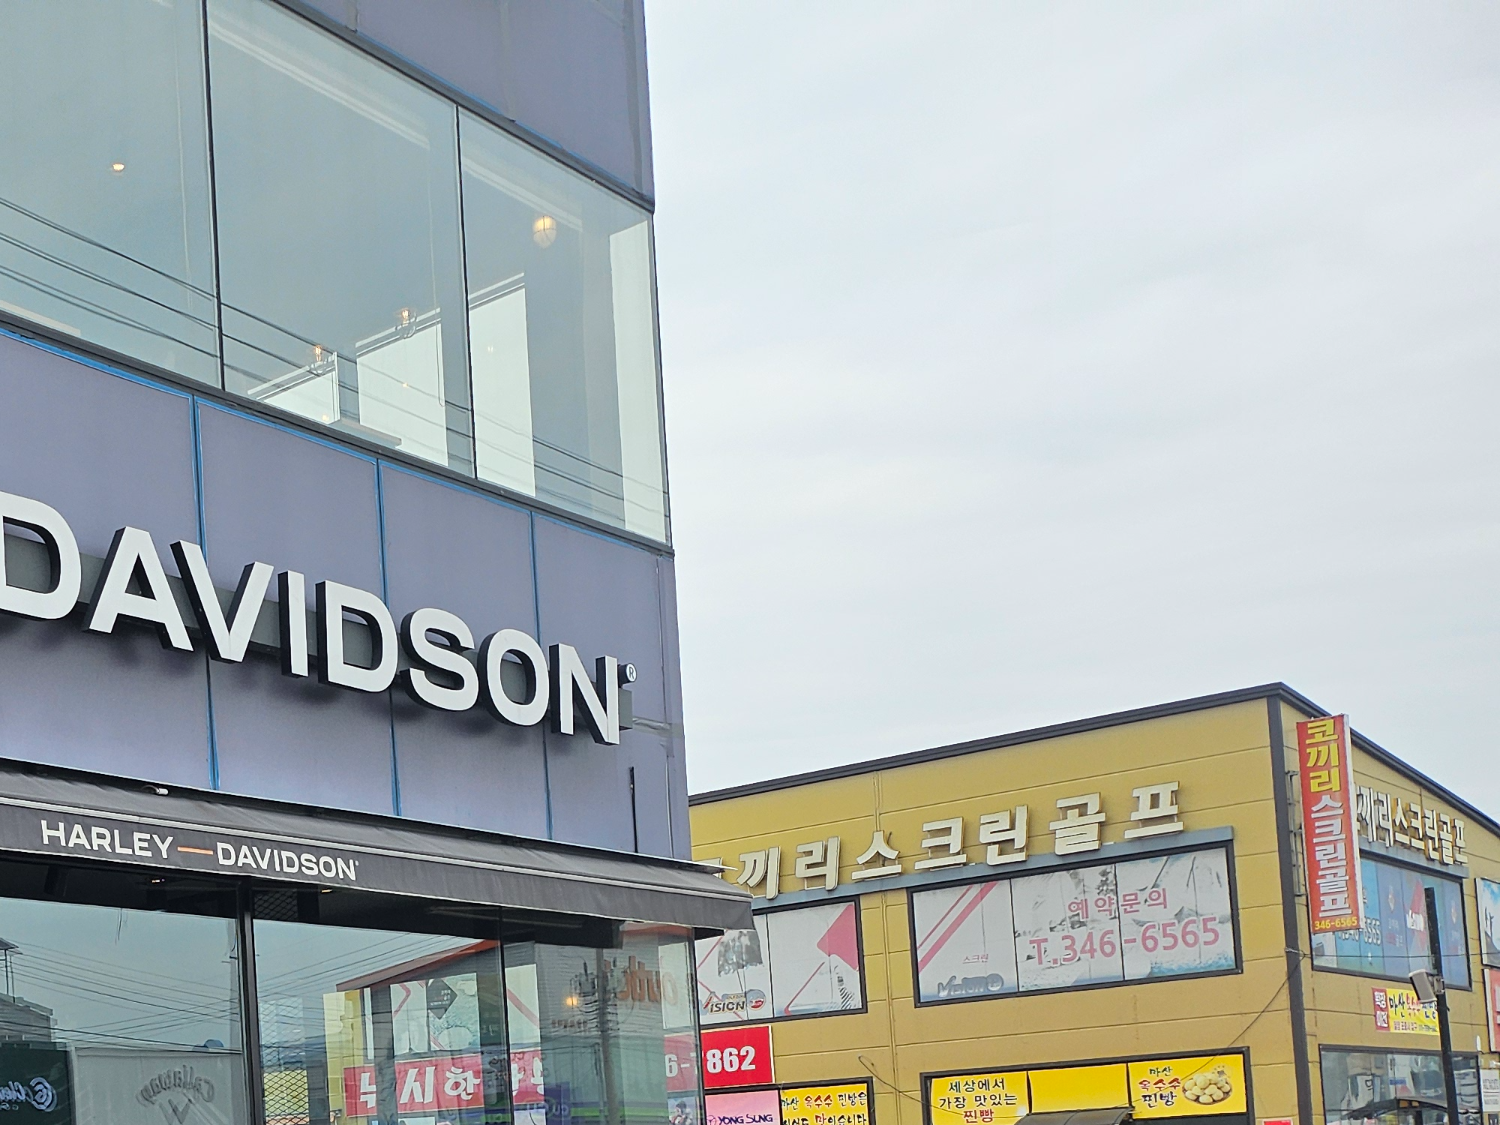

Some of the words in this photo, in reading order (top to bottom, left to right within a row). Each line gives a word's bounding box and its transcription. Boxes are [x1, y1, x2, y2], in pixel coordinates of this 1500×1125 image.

[700, 781, 1185, 900] 끼리스크린골프
[1355, 786, 1469, 866] 끼리스크린골프
[40, 820, 174, 859] HARLEY
[216, 842, 355, 881] DAVIDSON
[1314, 916, 1358, 930] 346-6565
[1029, 916, 1221, 966] T.346-6565
[664, 1045, 756, 1077] 6-862
[948, 1077, 1006, 1093] 세상에서
[938, 1095, 967, 1110] 가장
[974, 1093, 1018, 1108] 맛있는
[963, 1108, 995, 1124] 찐빵
